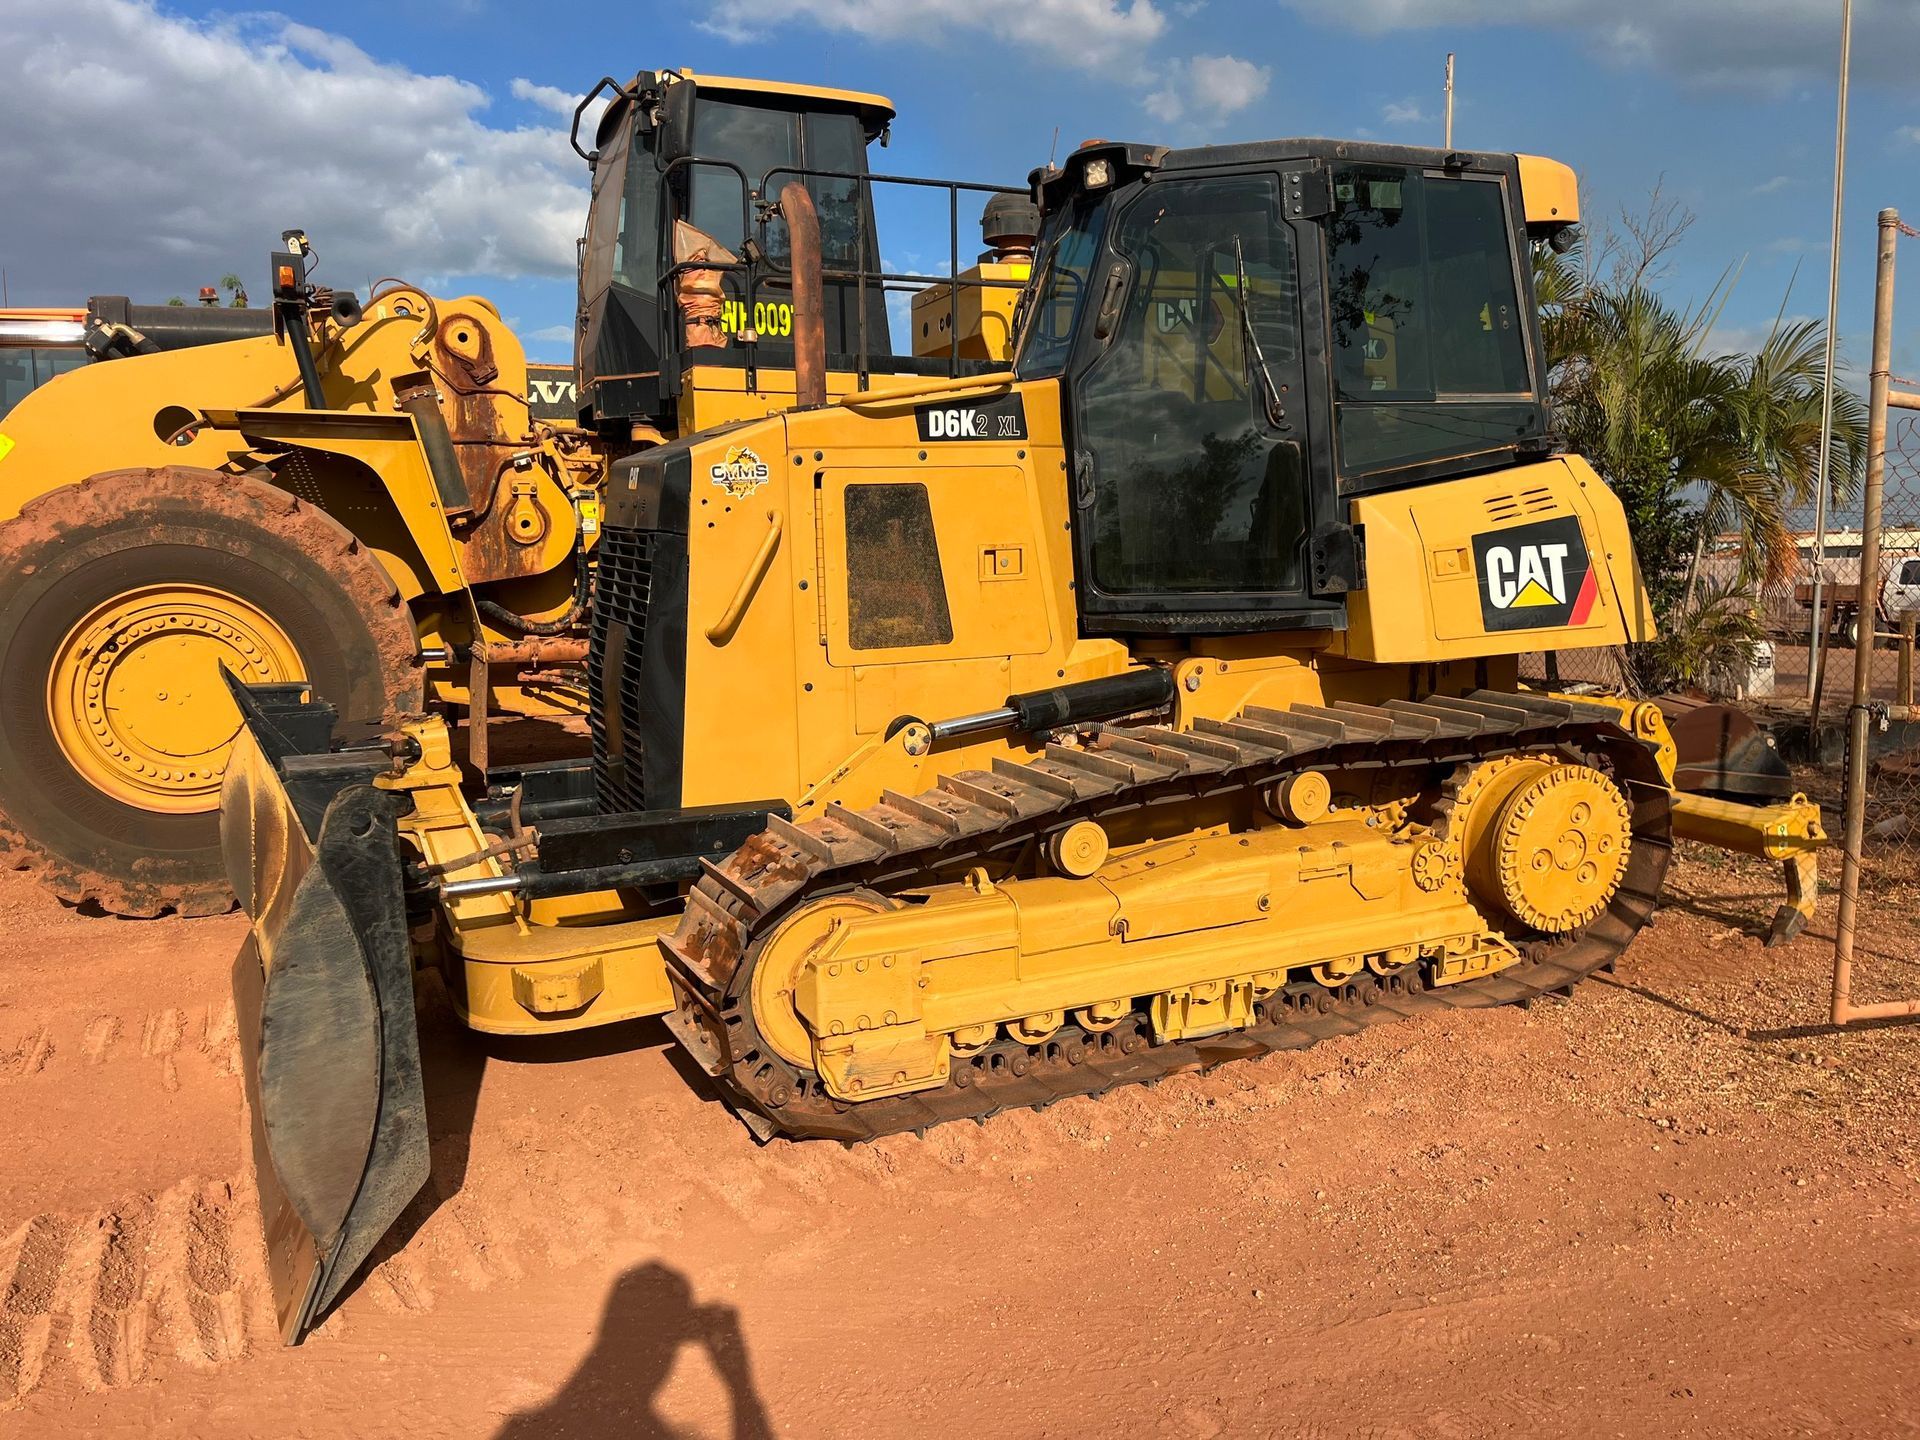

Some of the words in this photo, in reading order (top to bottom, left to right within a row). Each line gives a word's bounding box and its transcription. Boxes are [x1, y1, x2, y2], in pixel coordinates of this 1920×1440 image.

[720, 300, 794, 337] WH009
[1157, 299, 1197, 333] CA
[997, 416, 1020, 436] XL
[1486, 543, 1568, 609] CAT
